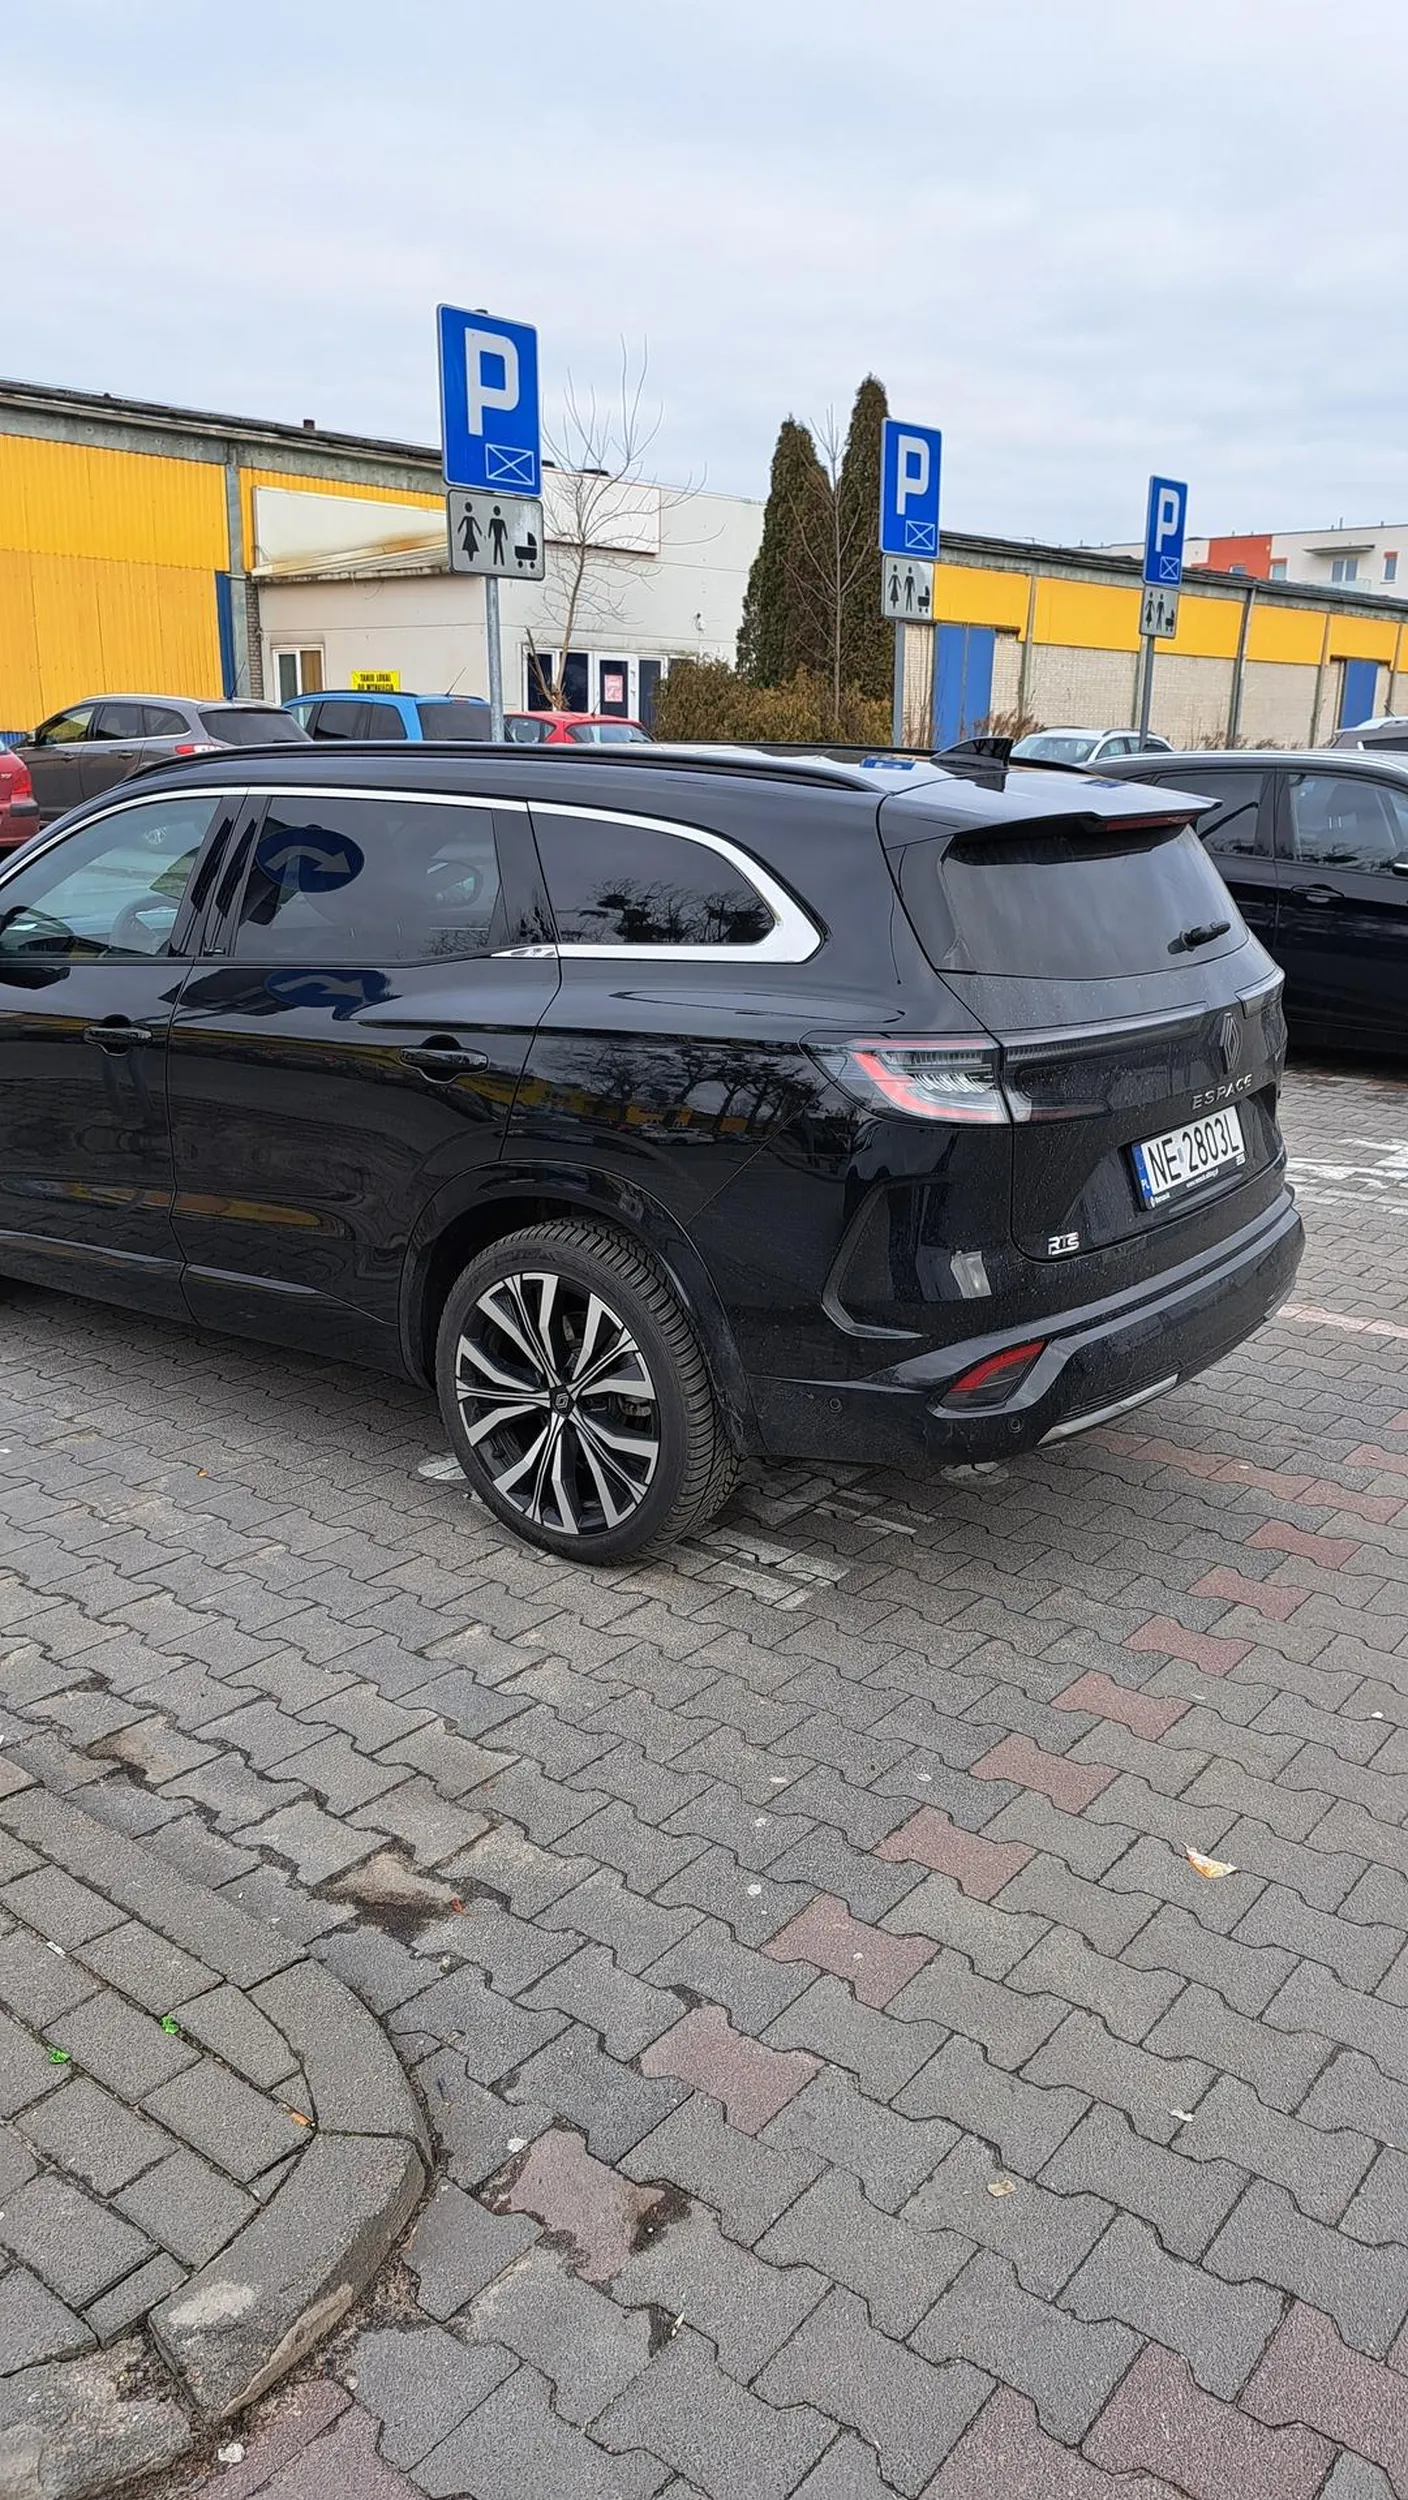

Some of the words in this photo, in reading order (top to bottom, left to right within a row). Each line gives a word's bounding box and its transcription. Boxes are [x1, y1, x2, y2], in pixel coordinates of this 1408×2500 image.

[464, 327, 519, 436] P
[896, 433, 930, 515] P
[1155, 487, 1179, 553] P
[1192, 1073, 1253, 1110] ESPACE
